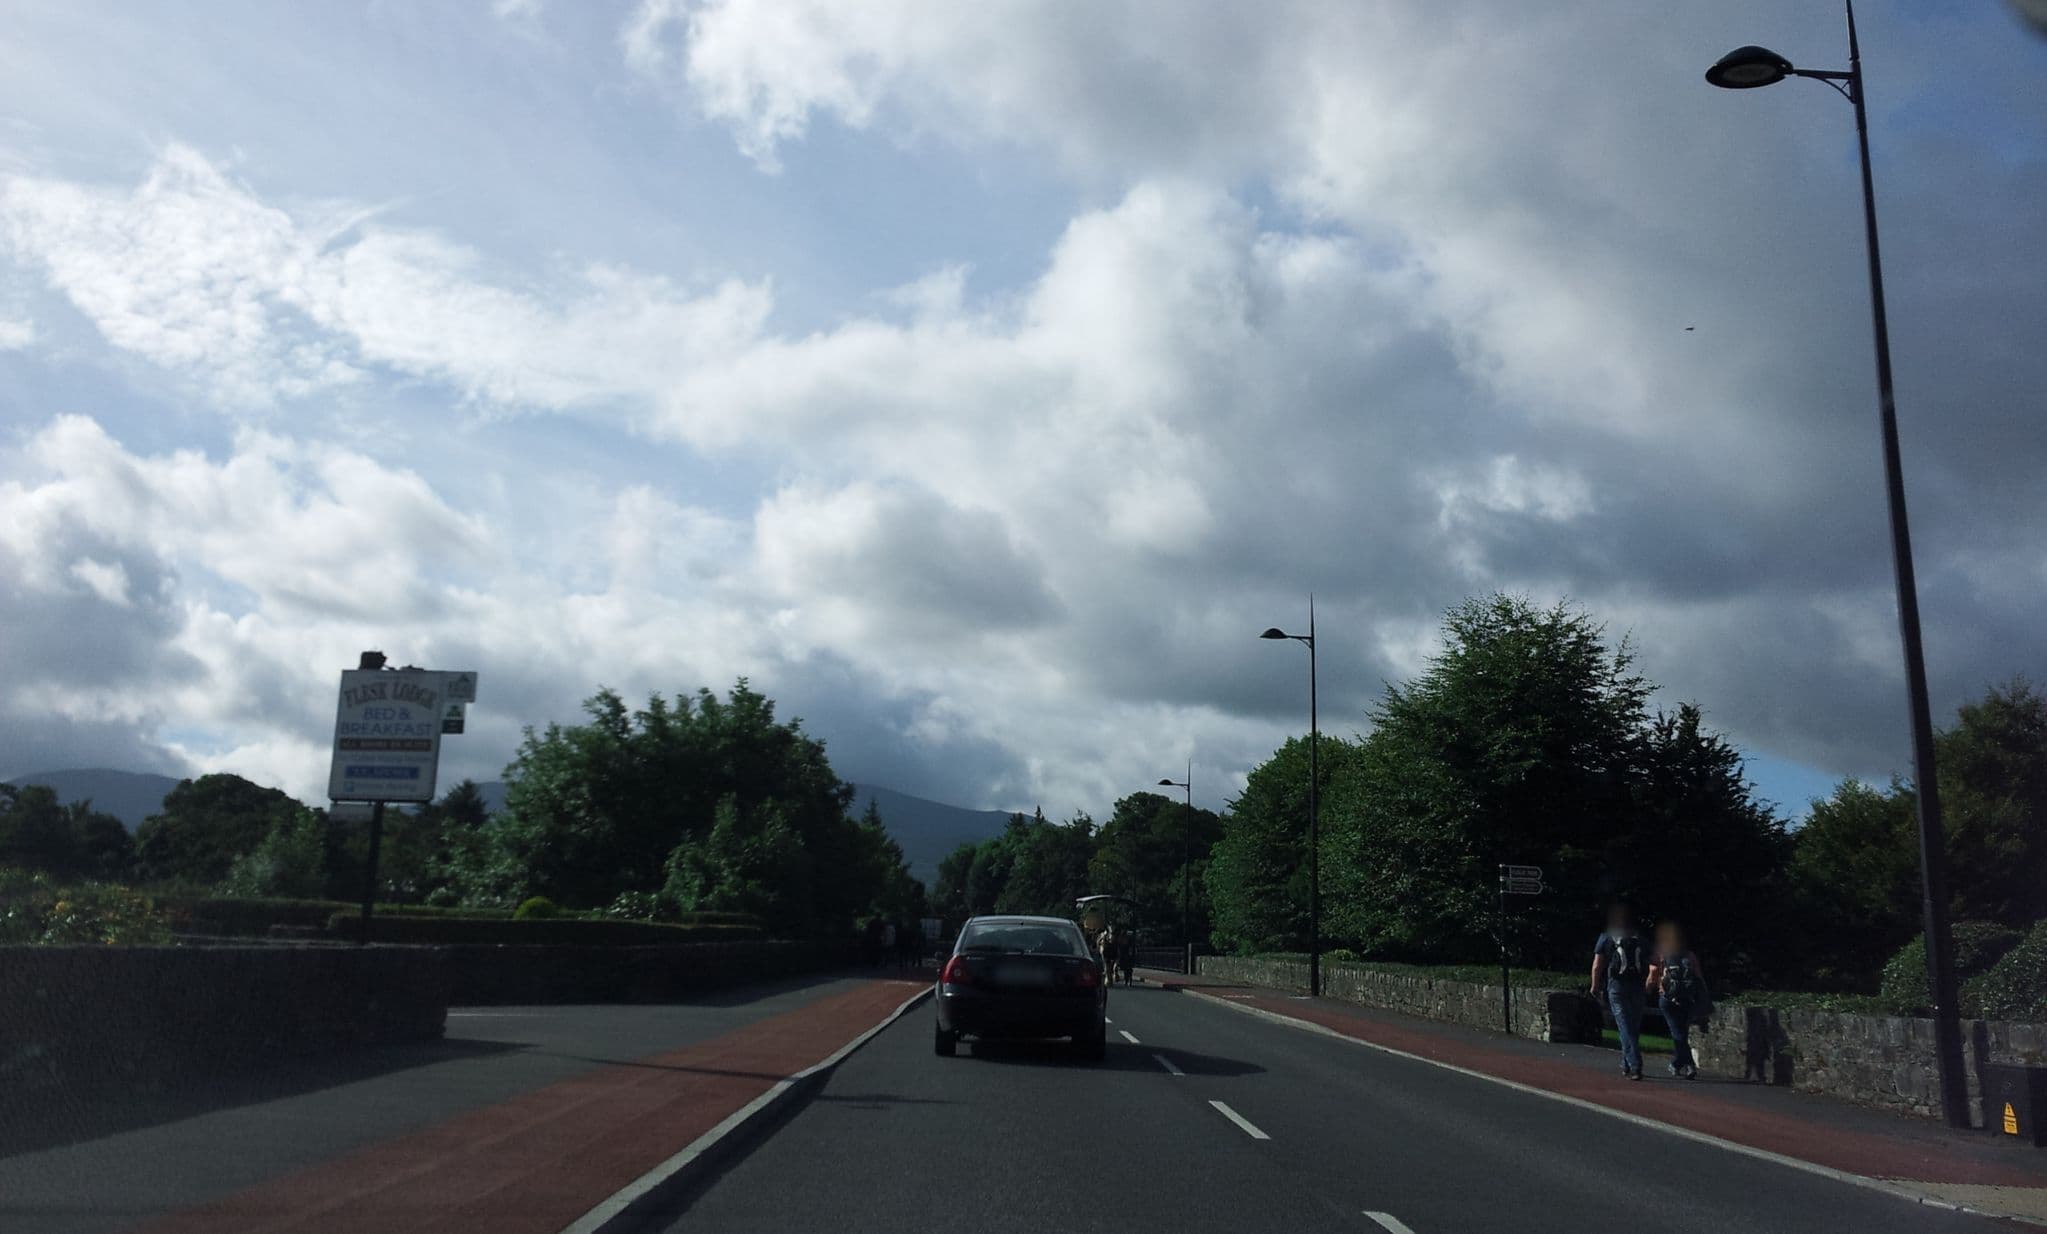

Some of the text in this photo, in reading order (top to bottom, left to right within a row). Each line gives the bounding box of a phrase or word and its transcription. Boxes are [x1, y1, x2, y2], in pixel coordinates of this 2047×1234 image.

[364, 707, 410, 720] BED &
[341, 722, 432, 736] BREAKFAST
